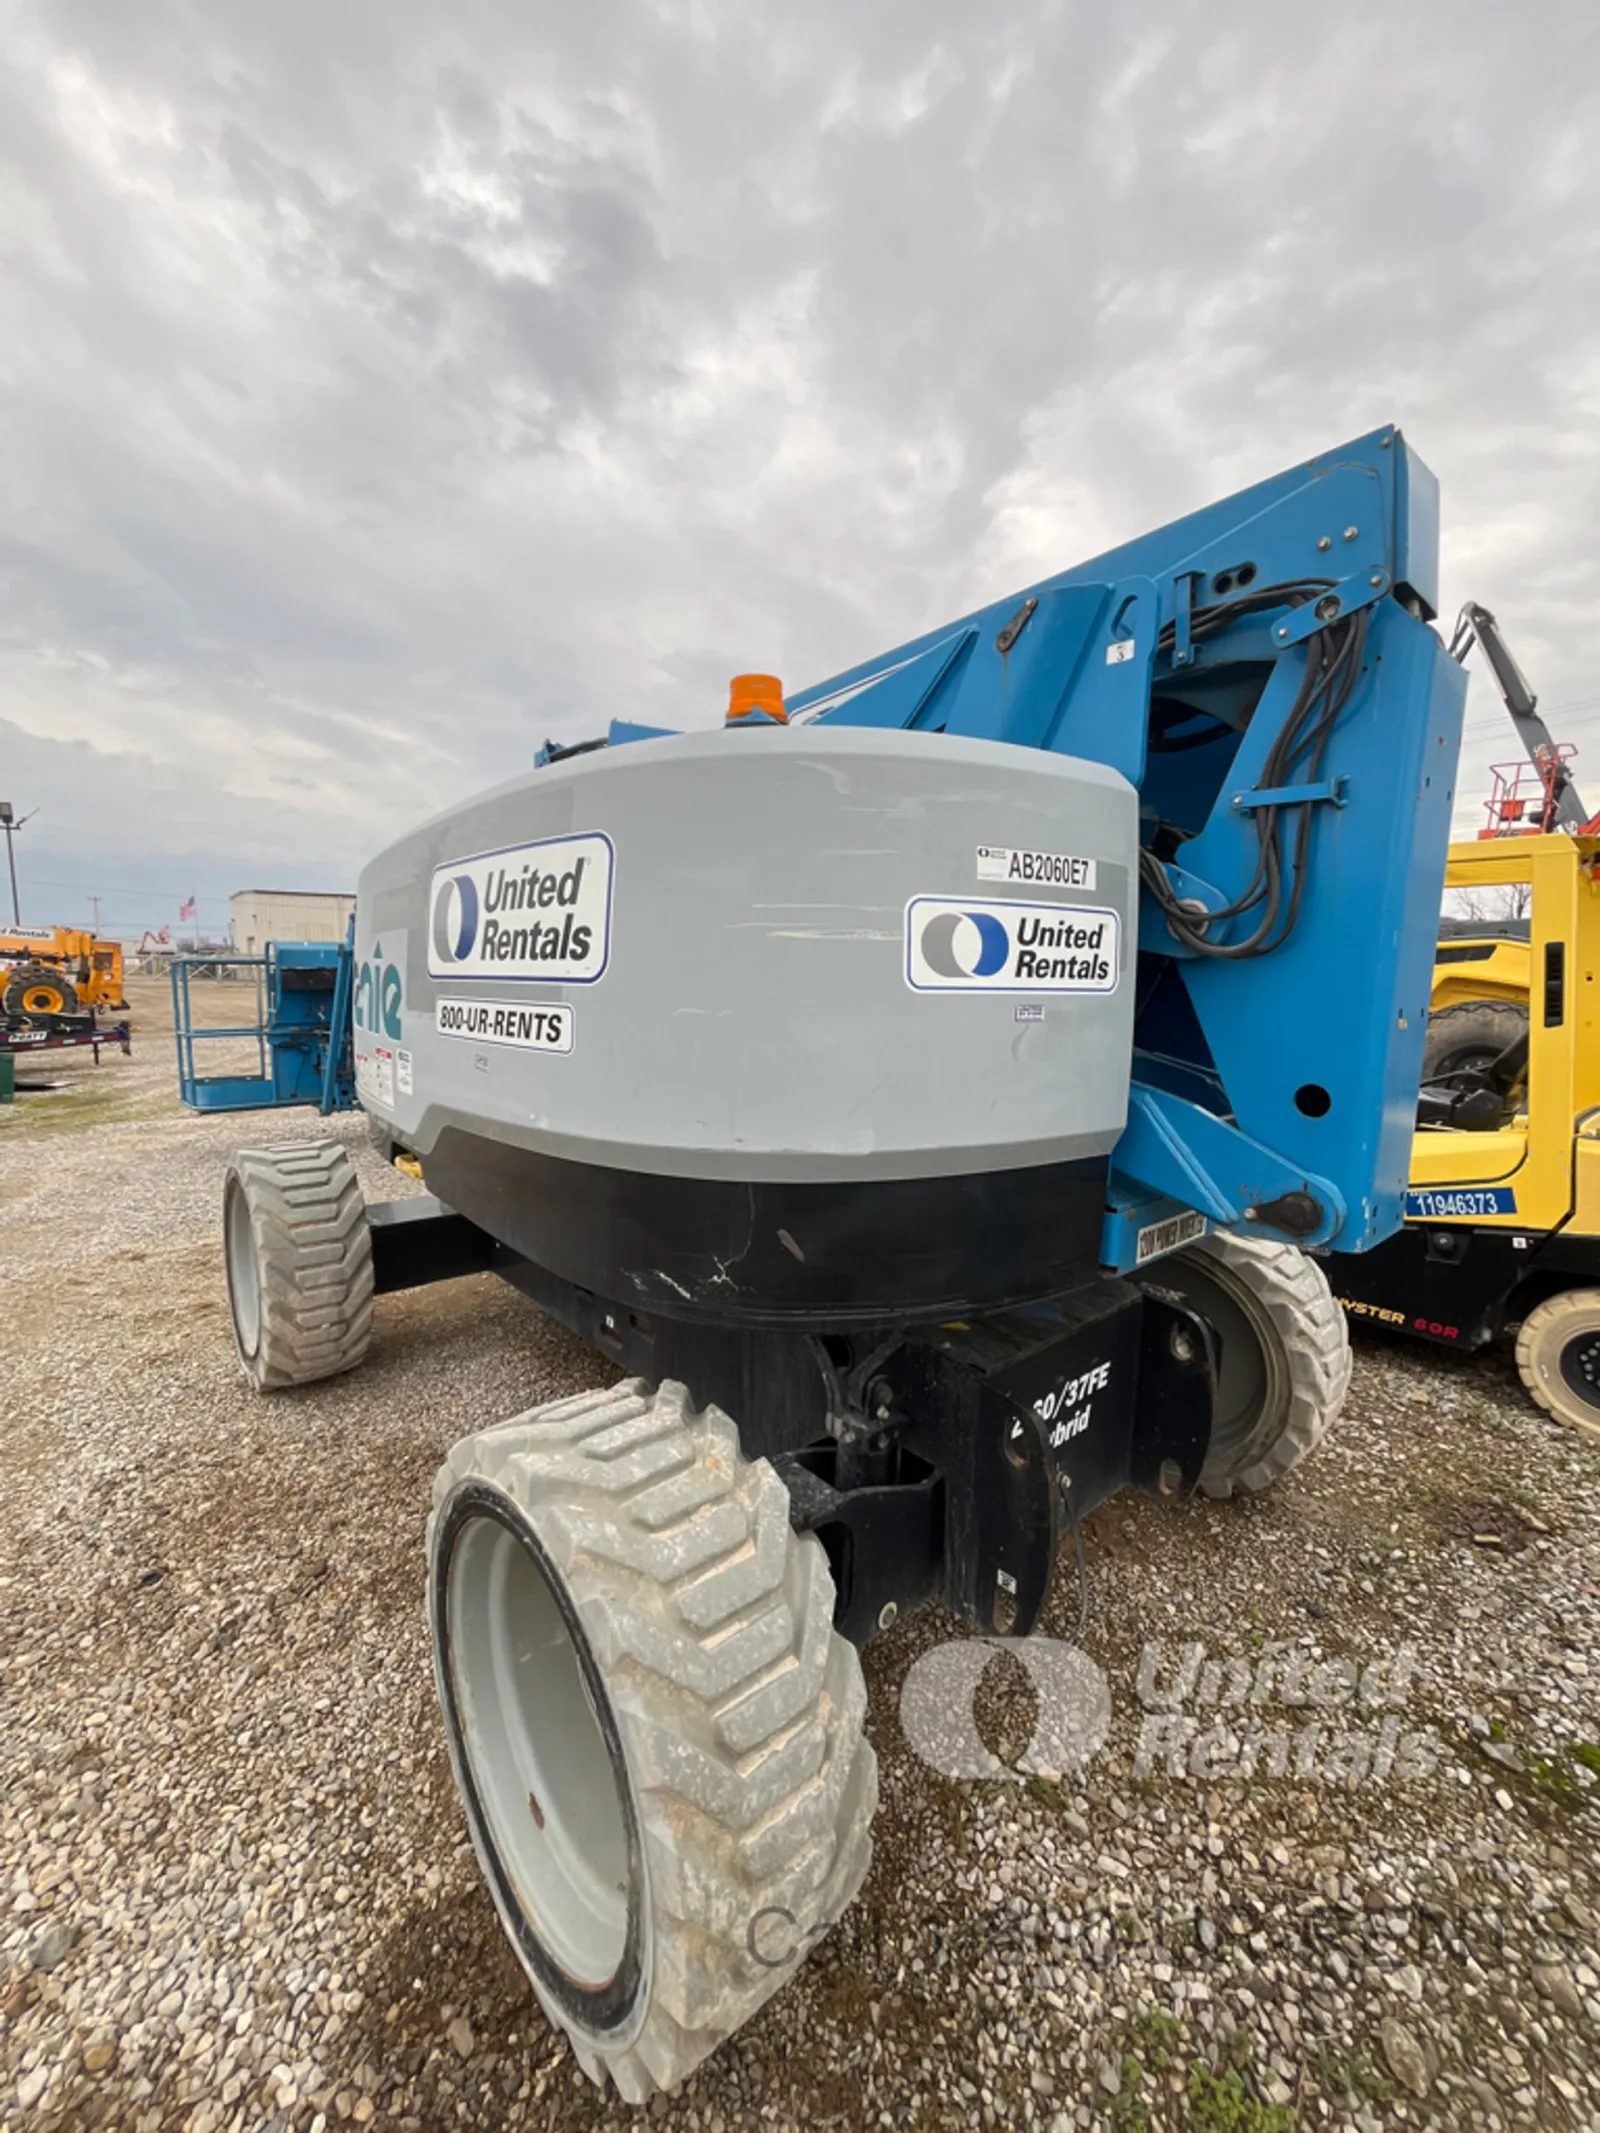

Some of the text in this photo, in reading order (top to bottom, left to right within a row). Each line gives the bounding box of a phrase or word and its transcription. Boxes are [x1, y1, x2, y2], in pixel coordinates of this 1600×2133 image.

[483, 857, 586, 913] United
[1008, 851, 1089, 885] AB2060E7
[480, 913, 593, 962] Rentals
[1017, 917, 1104, 949] United
[1014, 949, 1110, 981] Rentals
[440, 1005, 563, 1043] 800-UR-RENTS
[1416, 1192, 1499, 1217] 11946373
[1049, 1403, 1092, 1449] brid
